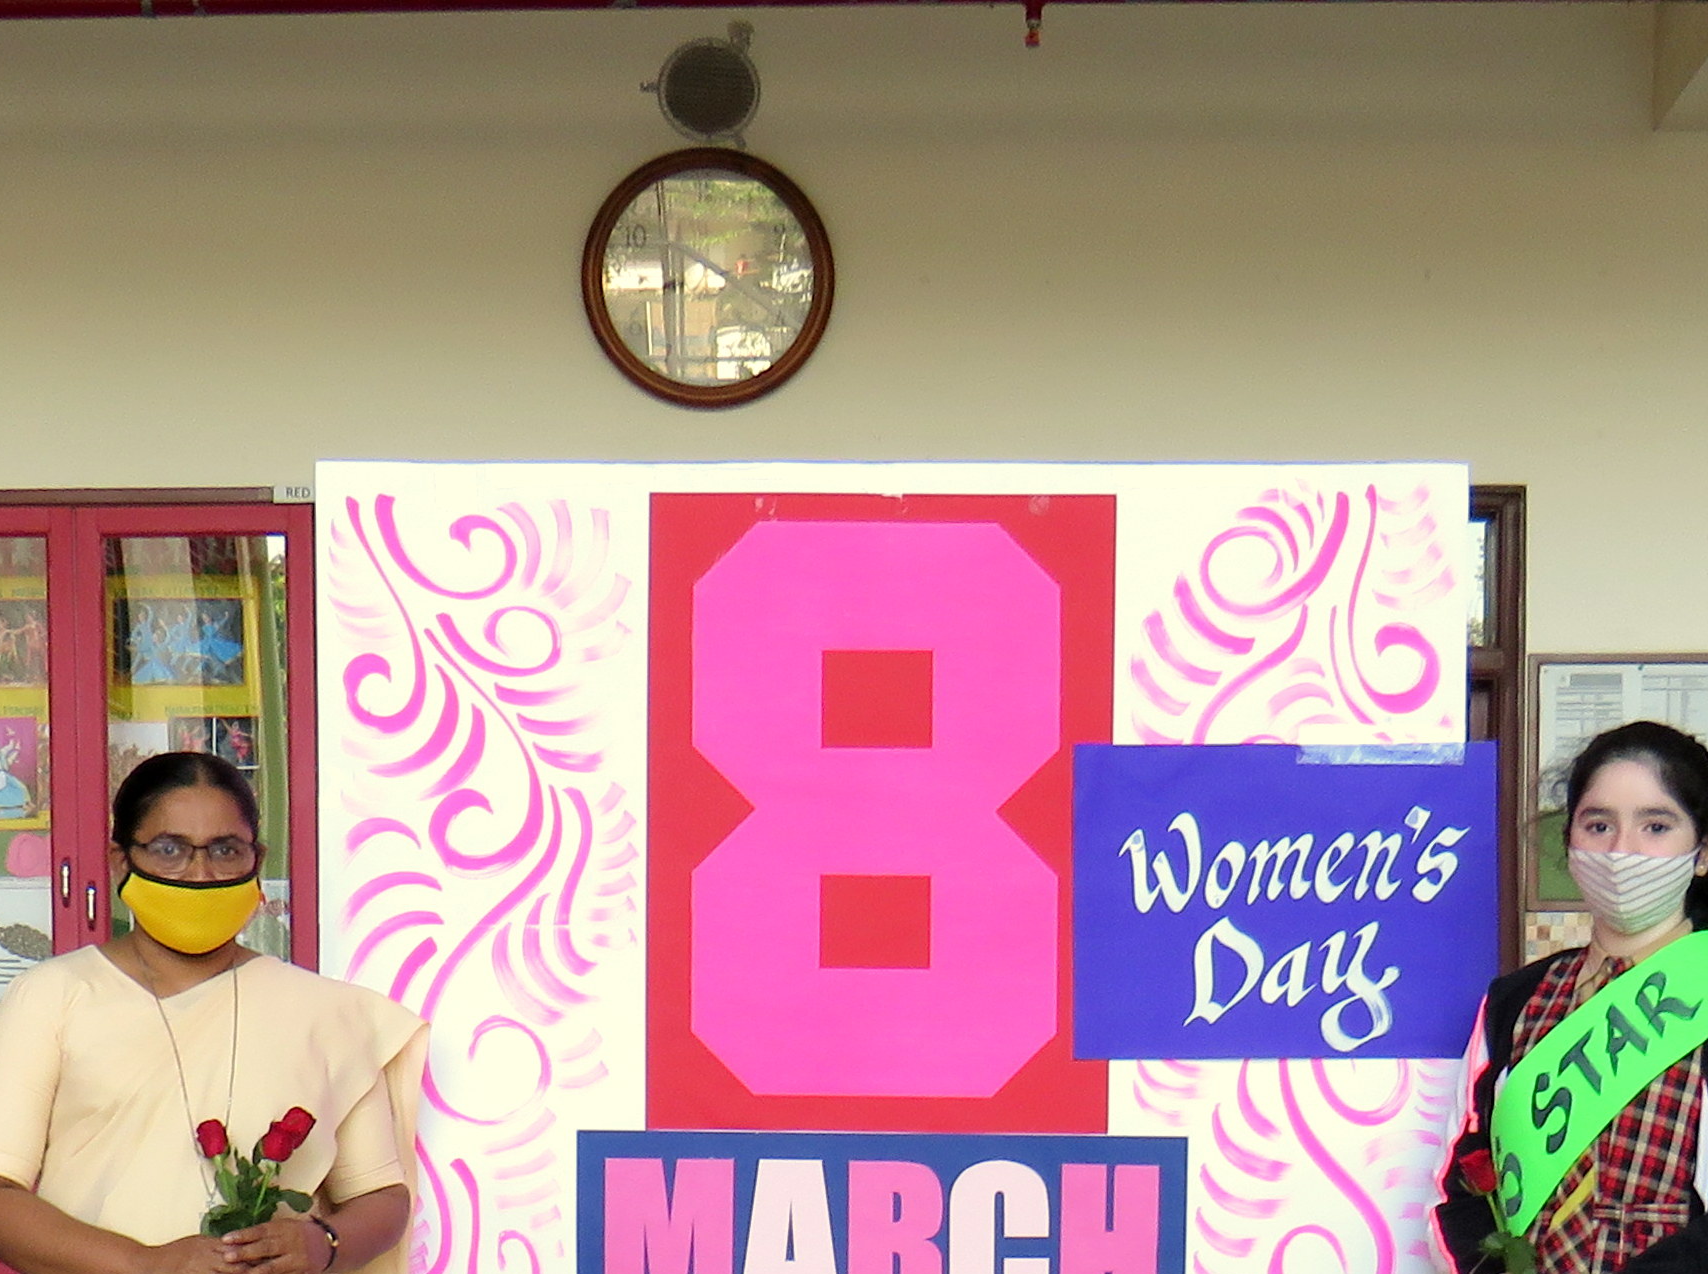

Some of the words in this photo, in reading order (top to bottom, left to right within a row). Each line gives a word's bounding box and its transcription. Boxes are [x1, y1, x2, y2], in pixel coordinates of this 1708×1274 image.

[285, 487, 311, 499] RED
[692, 520, 1061, 1097] 8
[1118, 804, 1472, 914] Women's
[1183, 916, 1401, 1053] Day
[1531, 970, 1704, 1154] STAR
